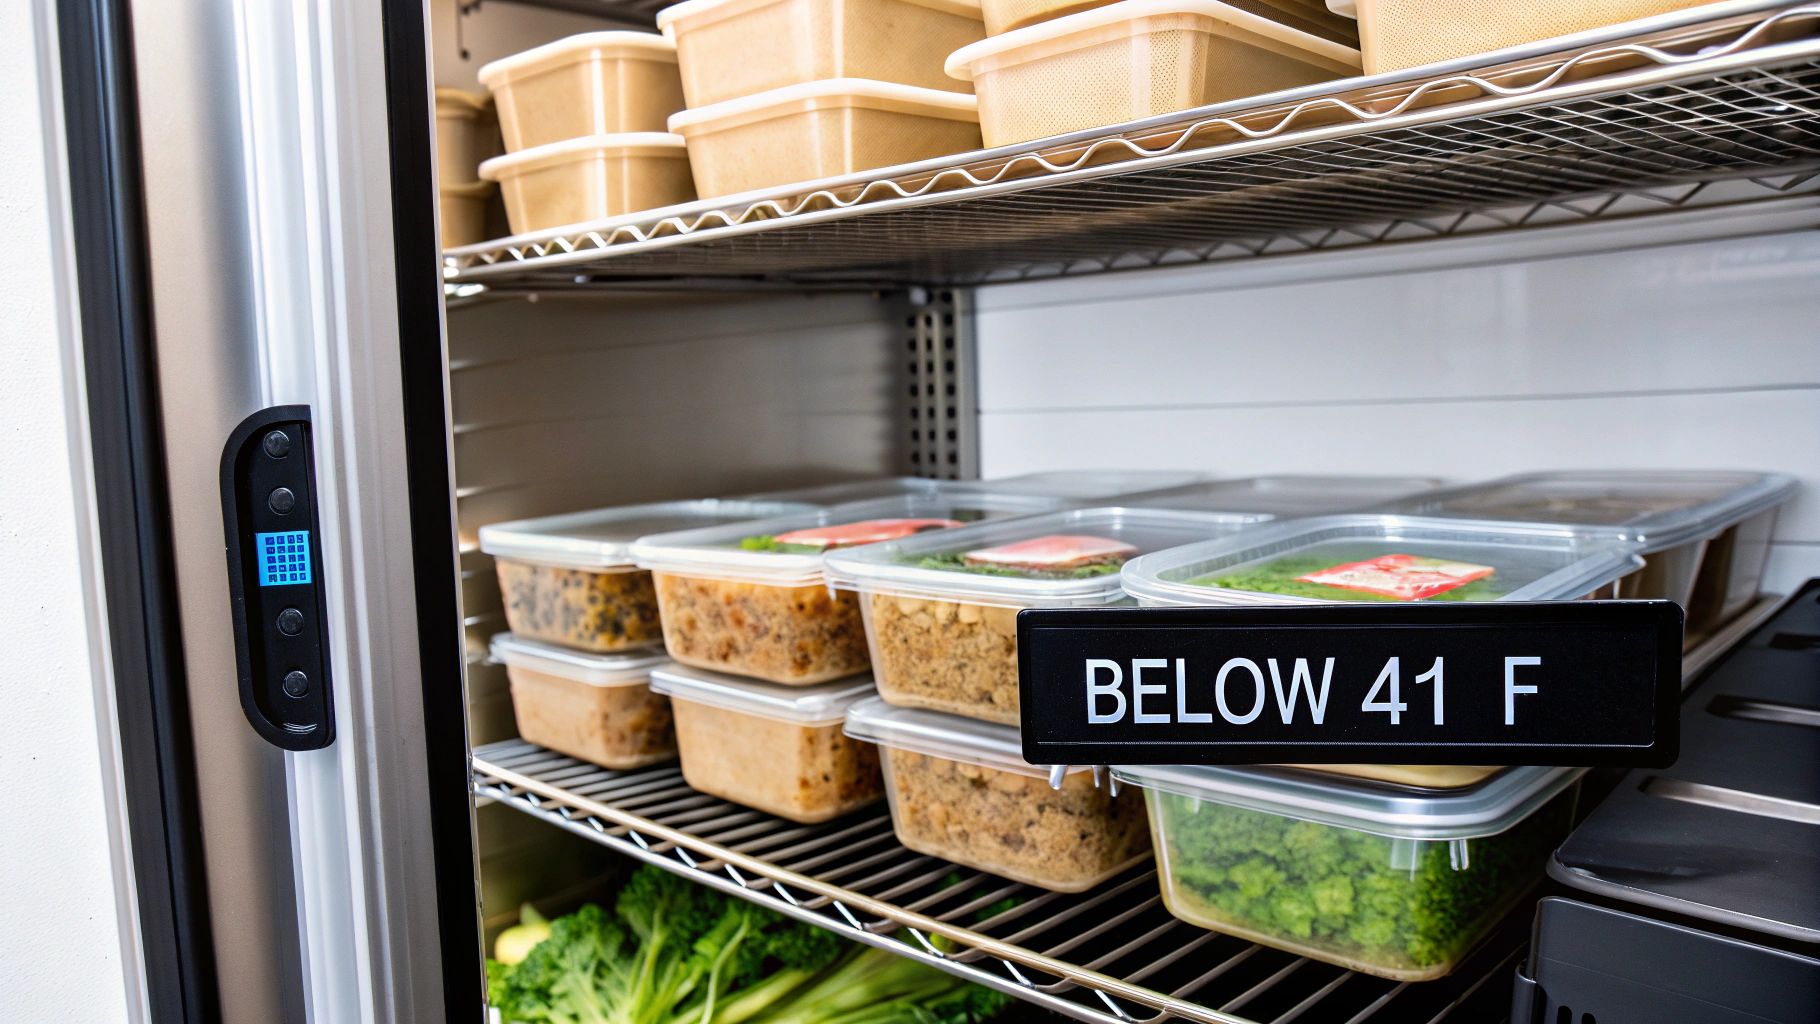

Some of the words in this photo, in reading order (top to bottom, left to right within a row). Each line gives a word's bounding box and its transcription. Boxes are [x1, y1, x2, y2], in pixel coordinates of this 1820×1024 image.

[1086, 657, 1336, 725] BELOW
[1361, 656, 1444, 725] 41
[1504, 656, 1542, 726] F
